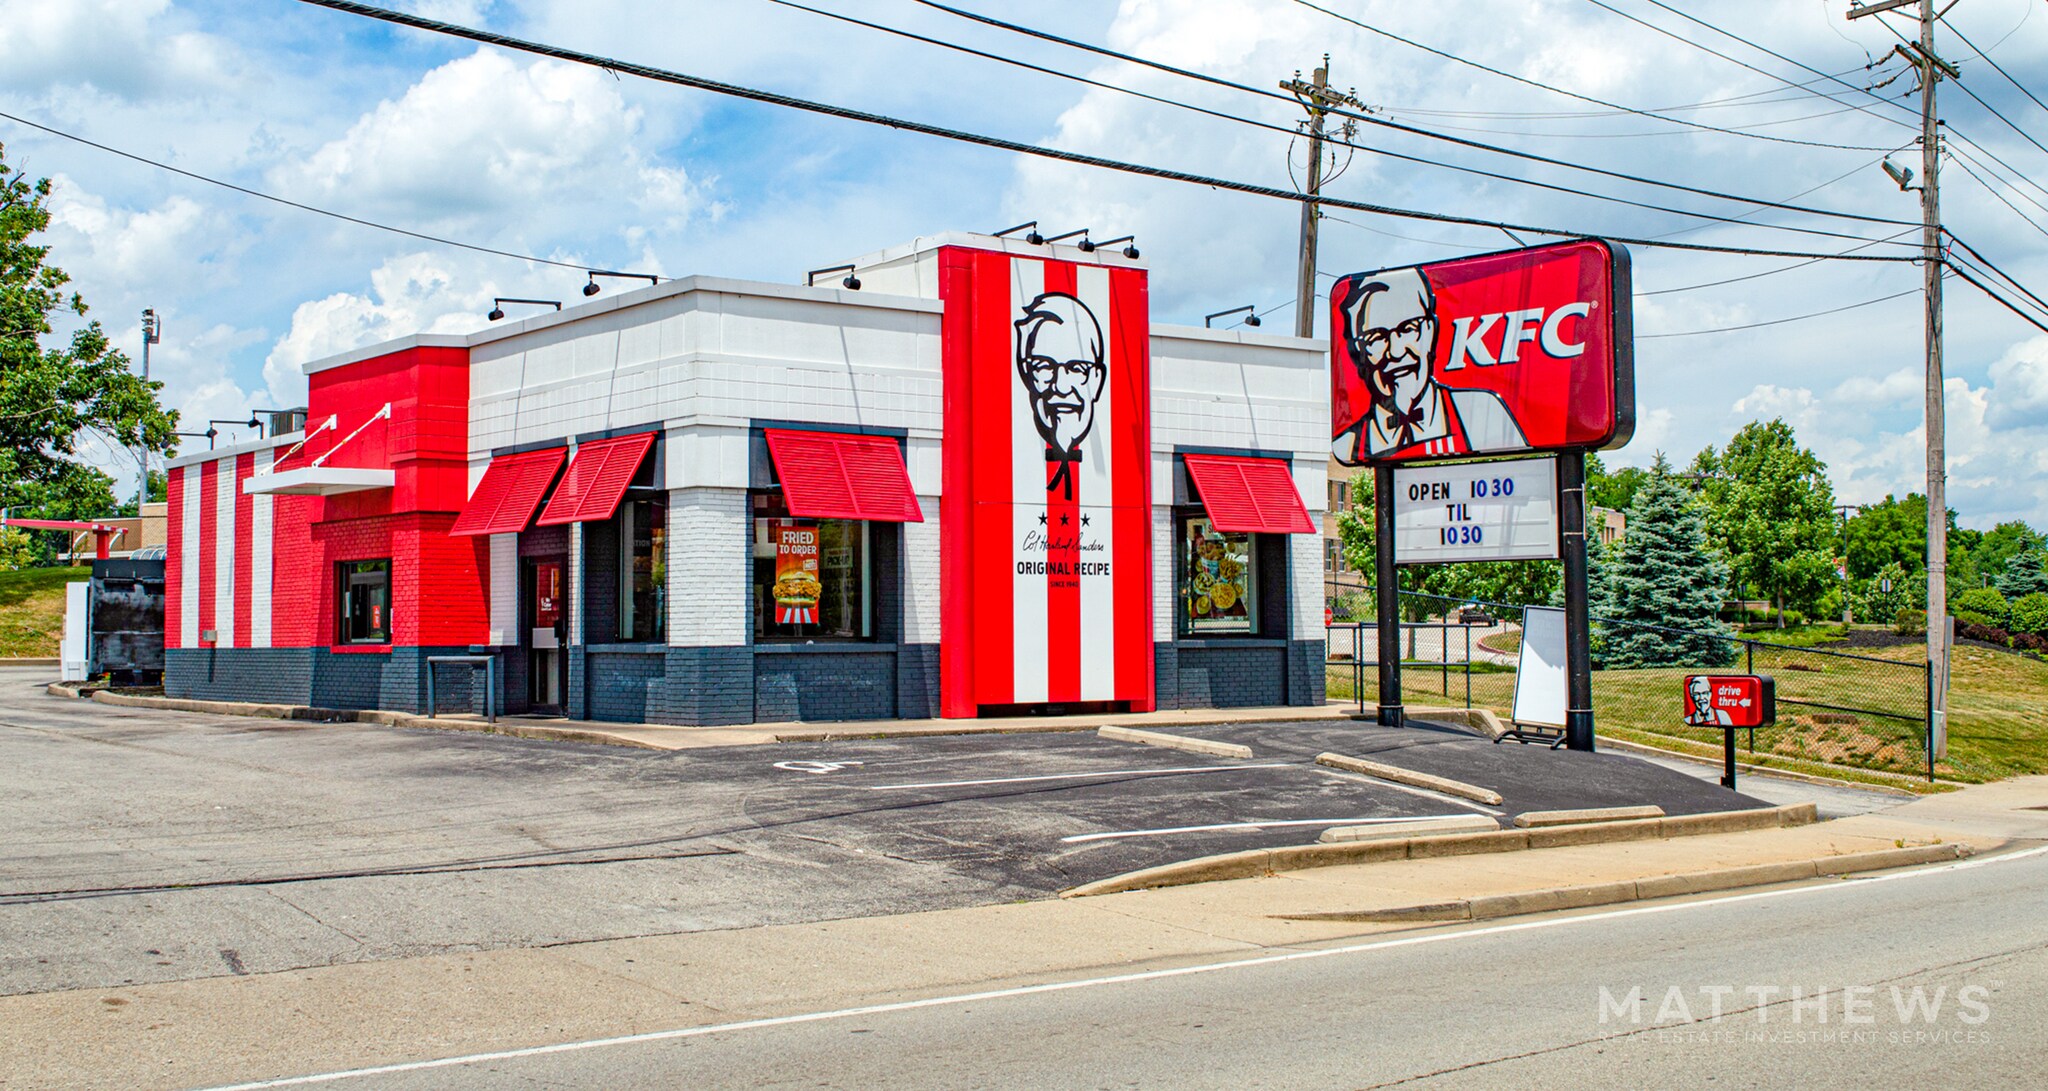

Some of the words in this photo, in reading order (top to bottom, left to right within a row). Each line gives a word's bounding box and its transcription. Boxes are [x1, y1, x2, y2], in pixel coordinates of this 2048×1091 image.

[1444, 302, 1591, 372] KFC
[1409, 482, 1450, 501] OPEN
[1446, 503, 1471, 521] TIL
[782, 531, 814, 544] FRIED
[780, 544, 790, 554] TO
[791, 544, 817, 555] ORDER
[1017, 561, 1071, 575] ORIGINAL
[1073, 562, 1110, 576] RECIPE
[1718, 685, 1741, 696] drive
[1718, 696, 1738, 707] thru
